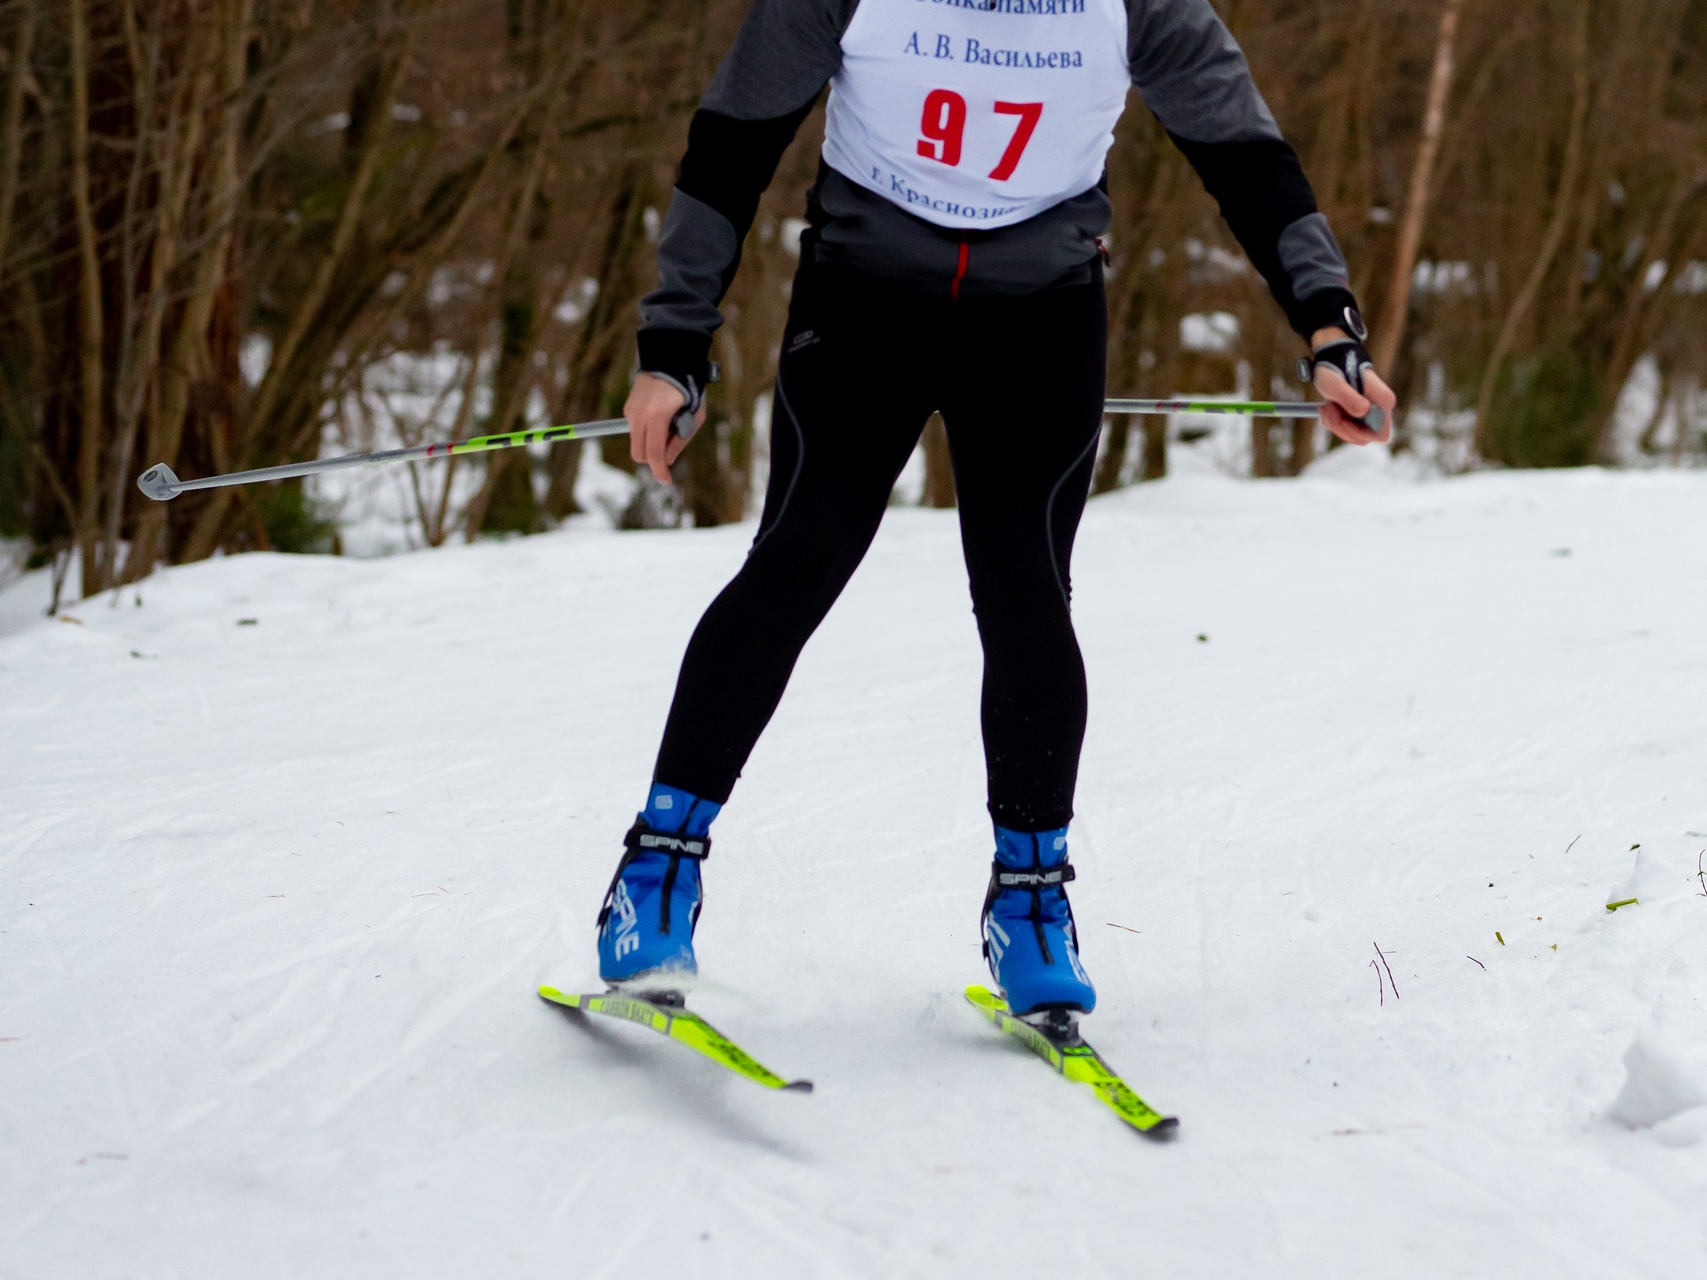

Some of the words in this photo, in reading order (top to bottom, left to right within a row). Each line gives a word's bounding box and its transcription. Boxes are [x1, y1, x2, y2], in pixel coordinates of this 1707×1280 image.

[963, 38, 1083, 69] Васильева
[916, 88, 1044, 182] 97
[639, 833, 704, 855] SPINE
[999, 870, 1062, 885] SPINE
